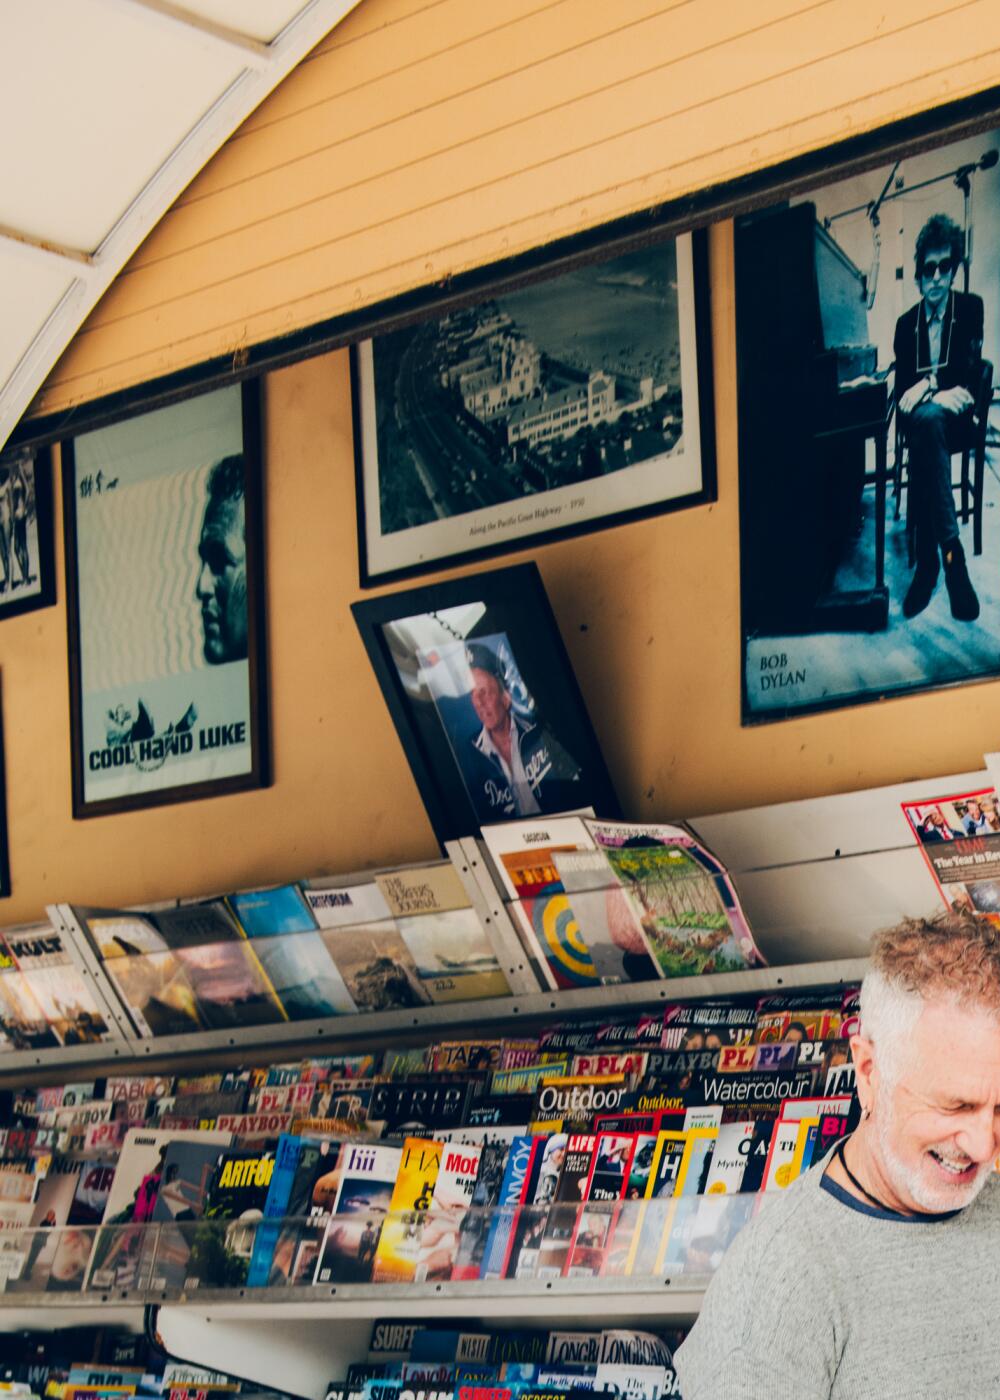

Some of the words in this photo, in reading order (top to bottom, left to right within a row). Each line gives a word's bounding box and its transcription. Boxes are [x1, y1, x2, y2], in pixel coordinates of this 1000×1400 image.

[759, 654, 788, 672] BOB
[759, 669, 806, 692] DYLAN
[89, 743, 135, 771] COOL
[200, 722, 245, 751] LUKE
[539, 1085, 626, 1111] Outdoor
[702, 1077, 811, 1102] Watercolour
[537, 1111, 593, 1121] Photography
[816, 1103, 844, 1114] TIME
[217, 1116, 291, 1133] PLAYBOY
